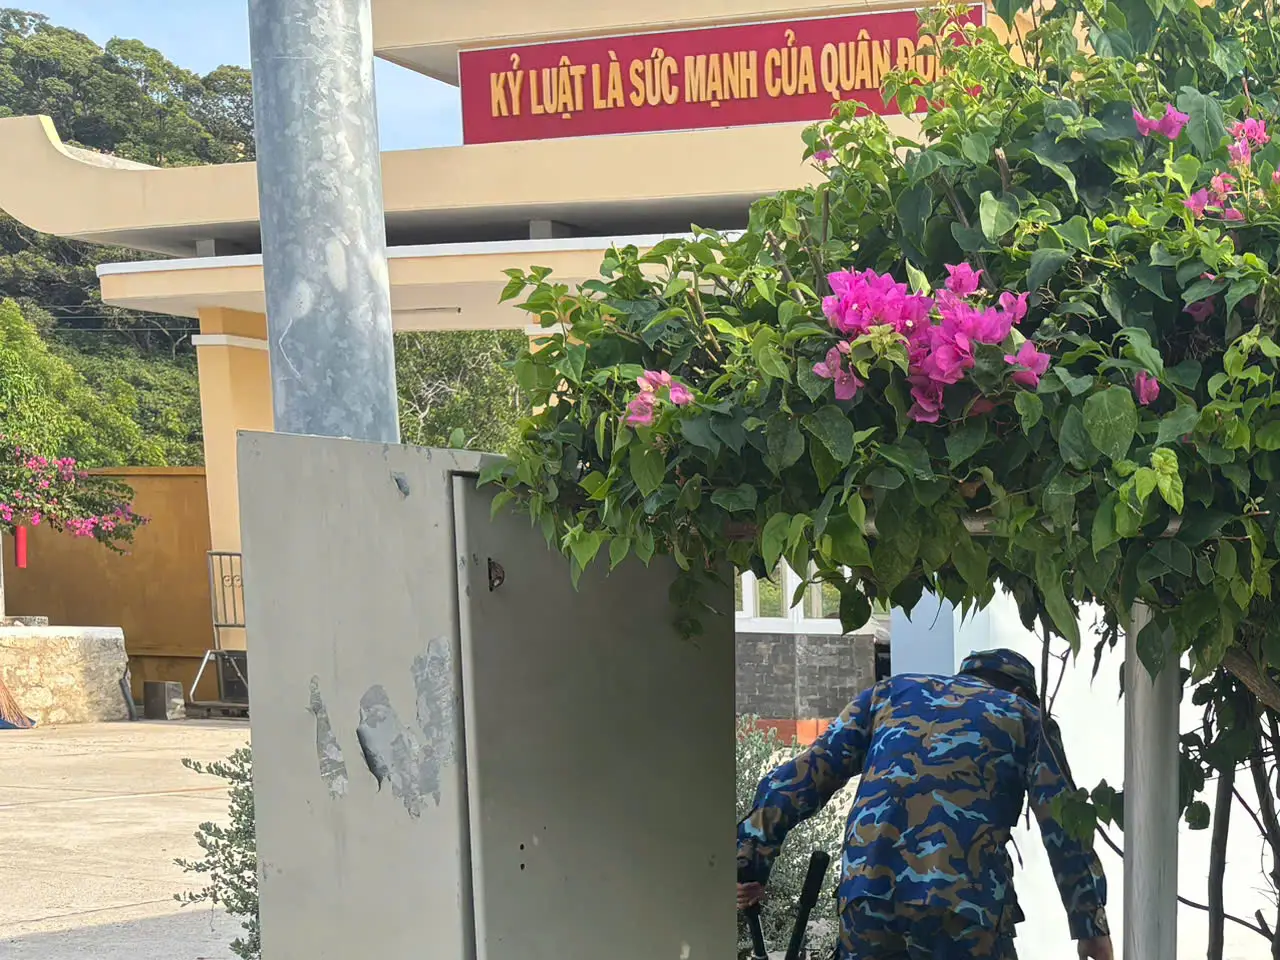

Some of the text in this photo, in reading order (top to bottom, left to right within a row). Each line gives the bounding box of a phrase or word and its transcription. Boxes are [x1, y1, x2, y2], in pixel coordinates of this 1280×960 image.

[490, 53, 524, 117] KỶ
[529, 55, 587, 119] LUẬT
[591, 50, 625, 109] LÀ
[629, 47, 680, 107] SỨC
[684, 50, 758, 108] MẠNH
[764, 28, 816, 97] CỦA
[820, 28, 891, 100] QUÂN
